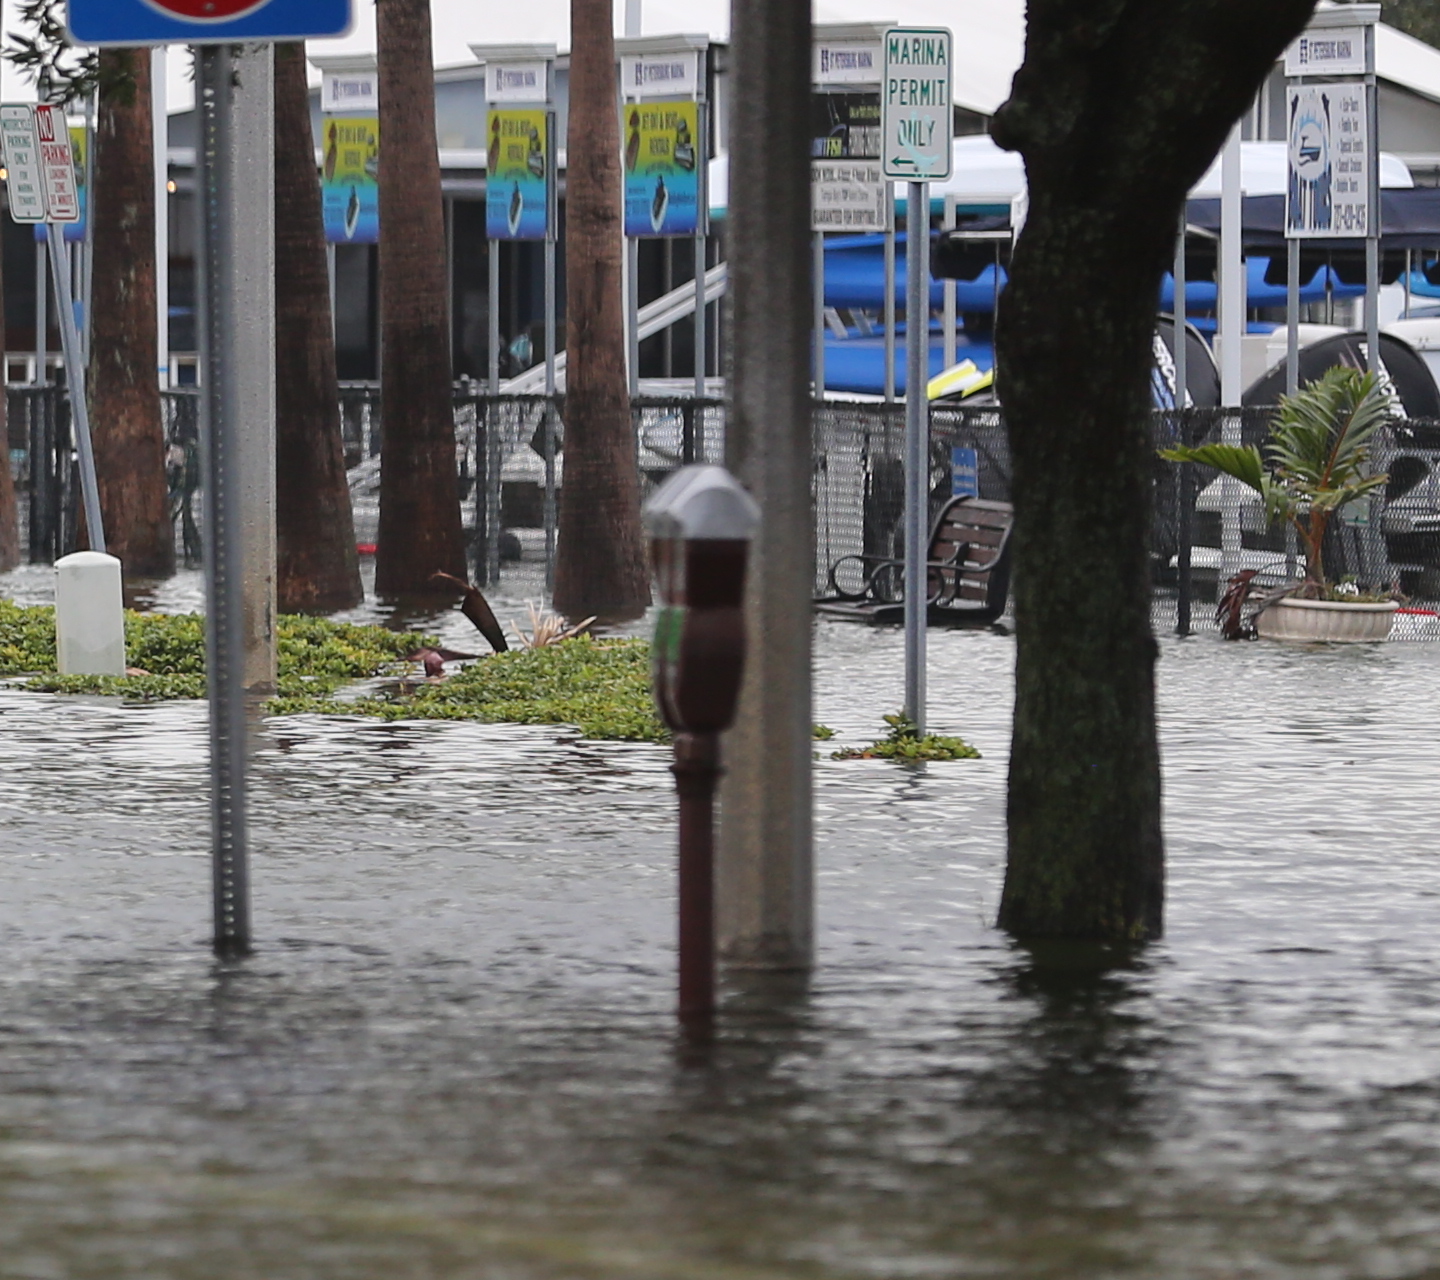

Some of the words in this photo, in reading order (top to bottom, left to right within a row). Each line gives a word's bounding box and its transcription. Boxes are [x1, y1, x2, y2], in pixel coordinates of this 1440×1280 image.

[888, 38, 946, 66] MARINA
[888, 79, 946, 106] PERMIT
[38, 109, 54, 141] NO
[897, 119, 935, 147] ONLY
[7, 135, 32, 148] PARKING
[41, 144, 70, 166] PARKING
[14, 152, 29, 165] ONLY
